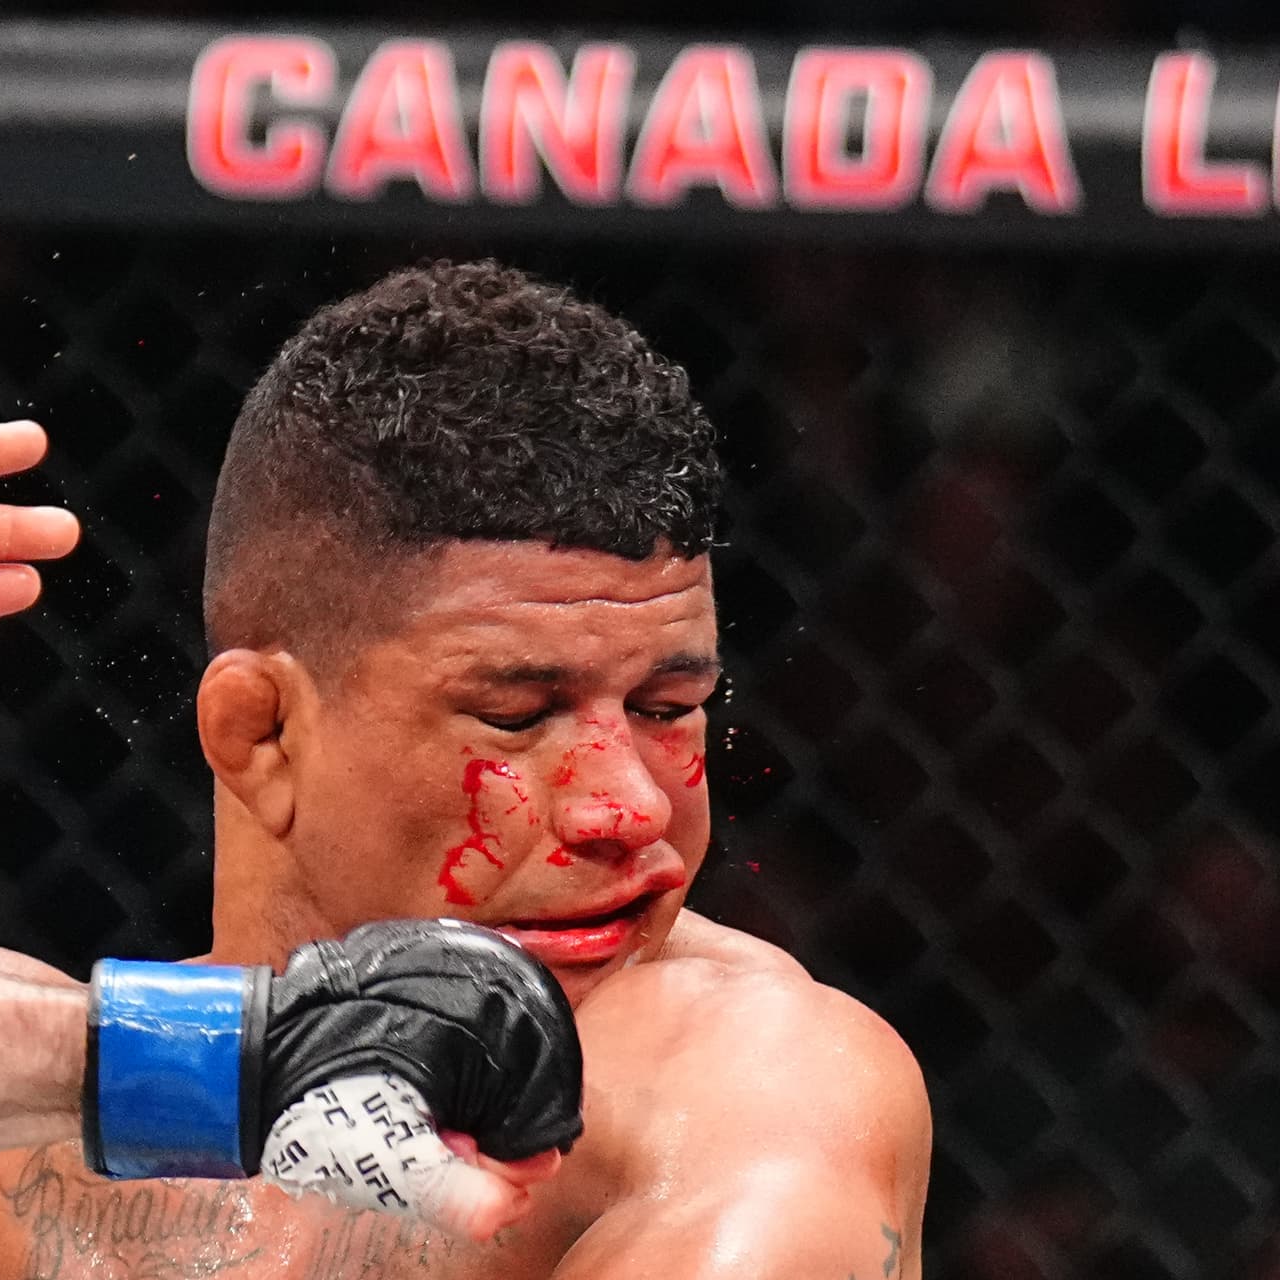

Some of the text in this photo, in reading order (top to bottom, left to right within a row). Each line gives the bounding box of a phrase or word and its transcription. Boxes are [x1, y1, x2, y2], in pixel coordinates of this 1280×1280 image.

[186, 35, 1280, 218] CANADA L
[354, 1153, 409, 1208] UFC
